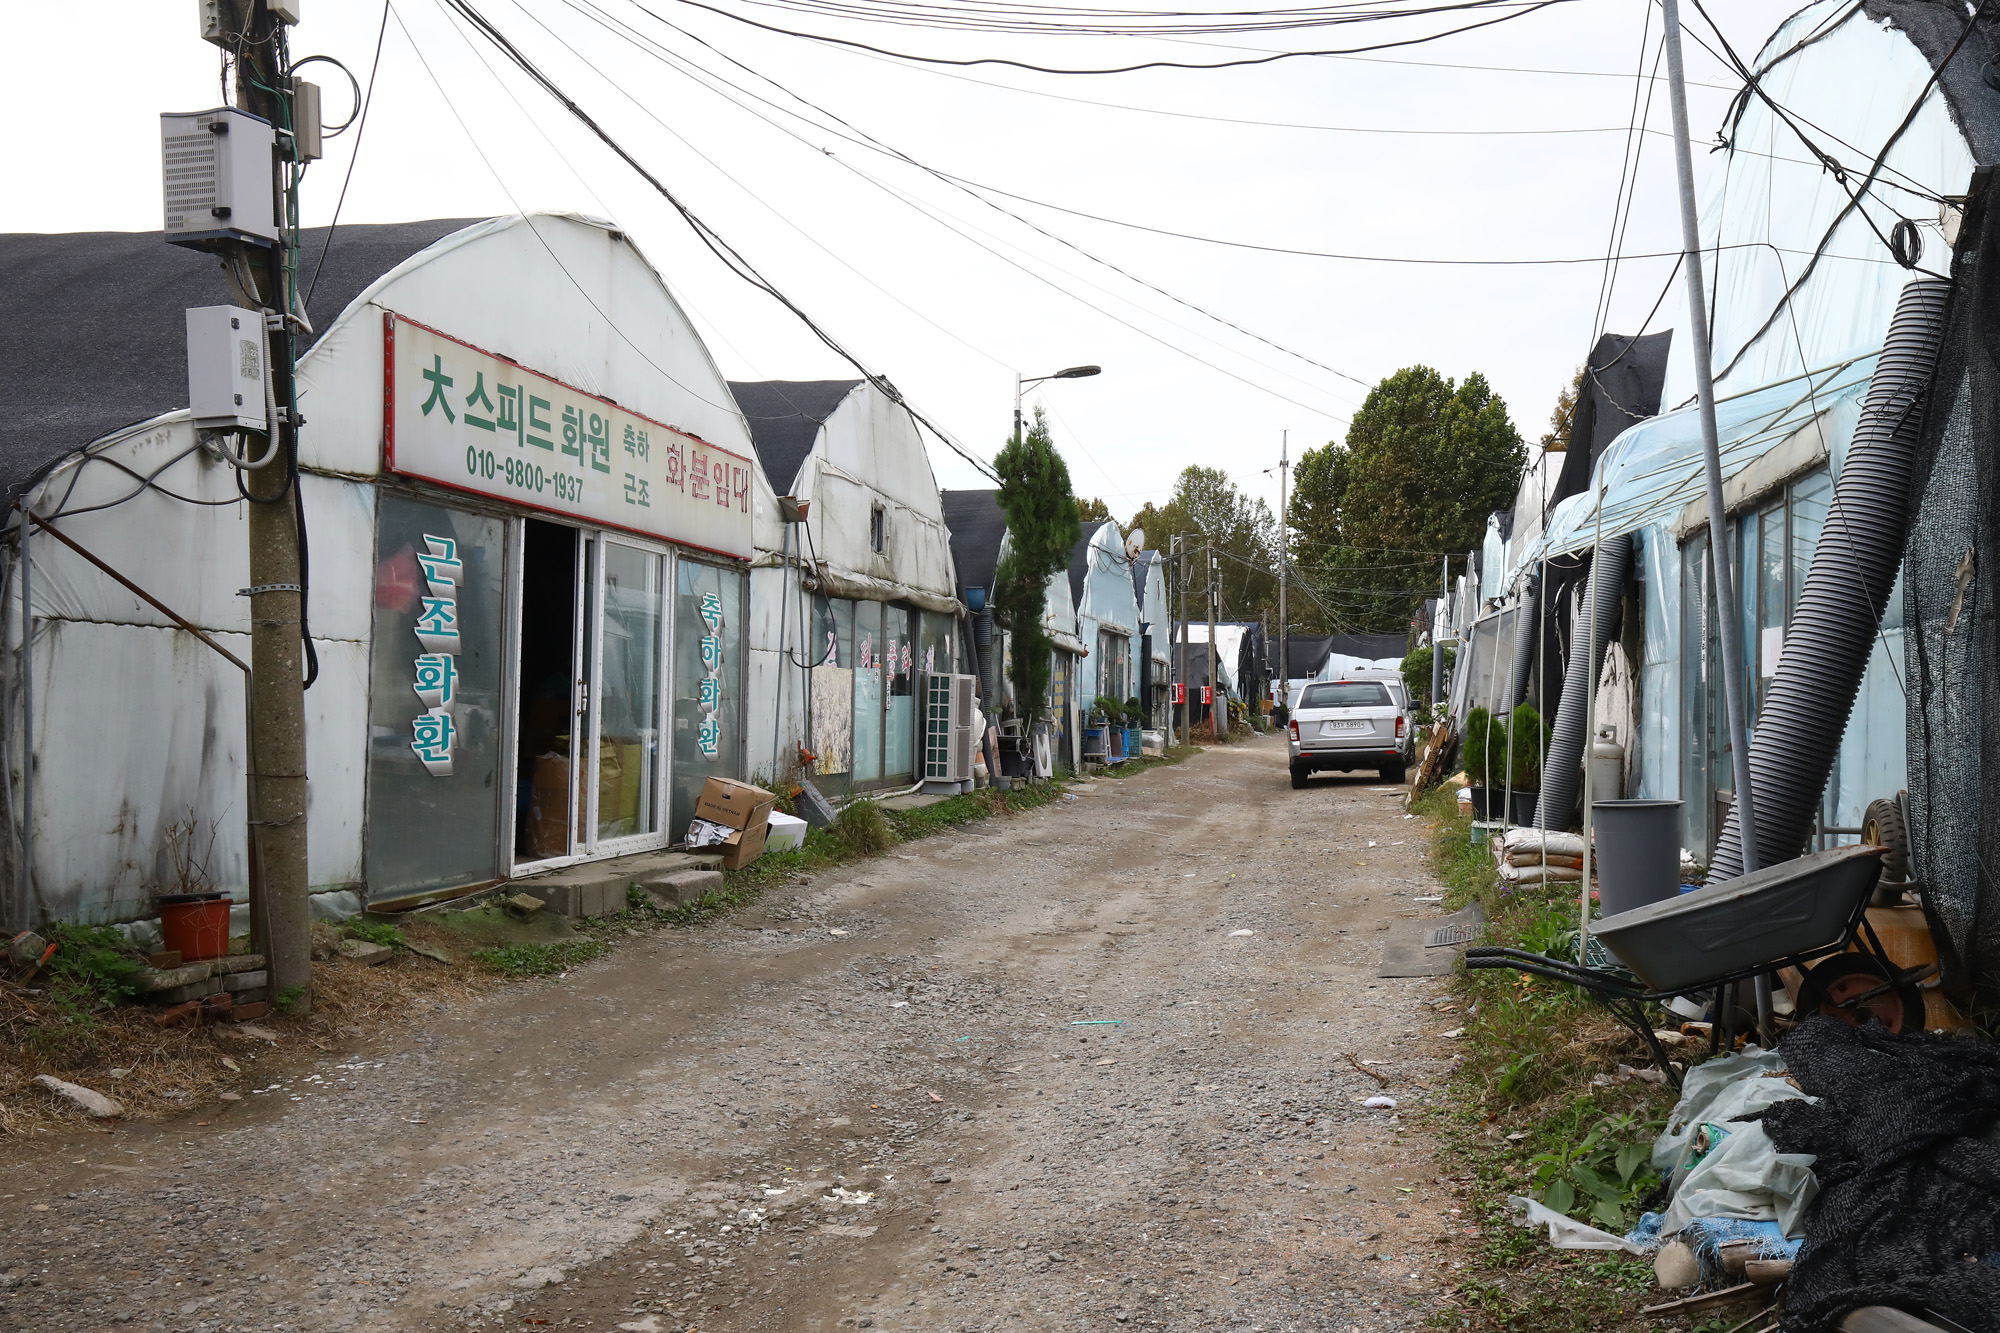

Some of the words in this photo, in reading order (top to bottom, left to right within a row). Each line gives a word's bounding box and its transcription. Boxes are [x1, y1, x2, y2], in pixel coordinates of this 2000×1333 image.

[623, 423, 650, 463] 축하
[466, 445, 583, 504] 010-9800-1937
[623, 472, 651, 508] 근조
[722, 807, 740, 815] VIETNAM
